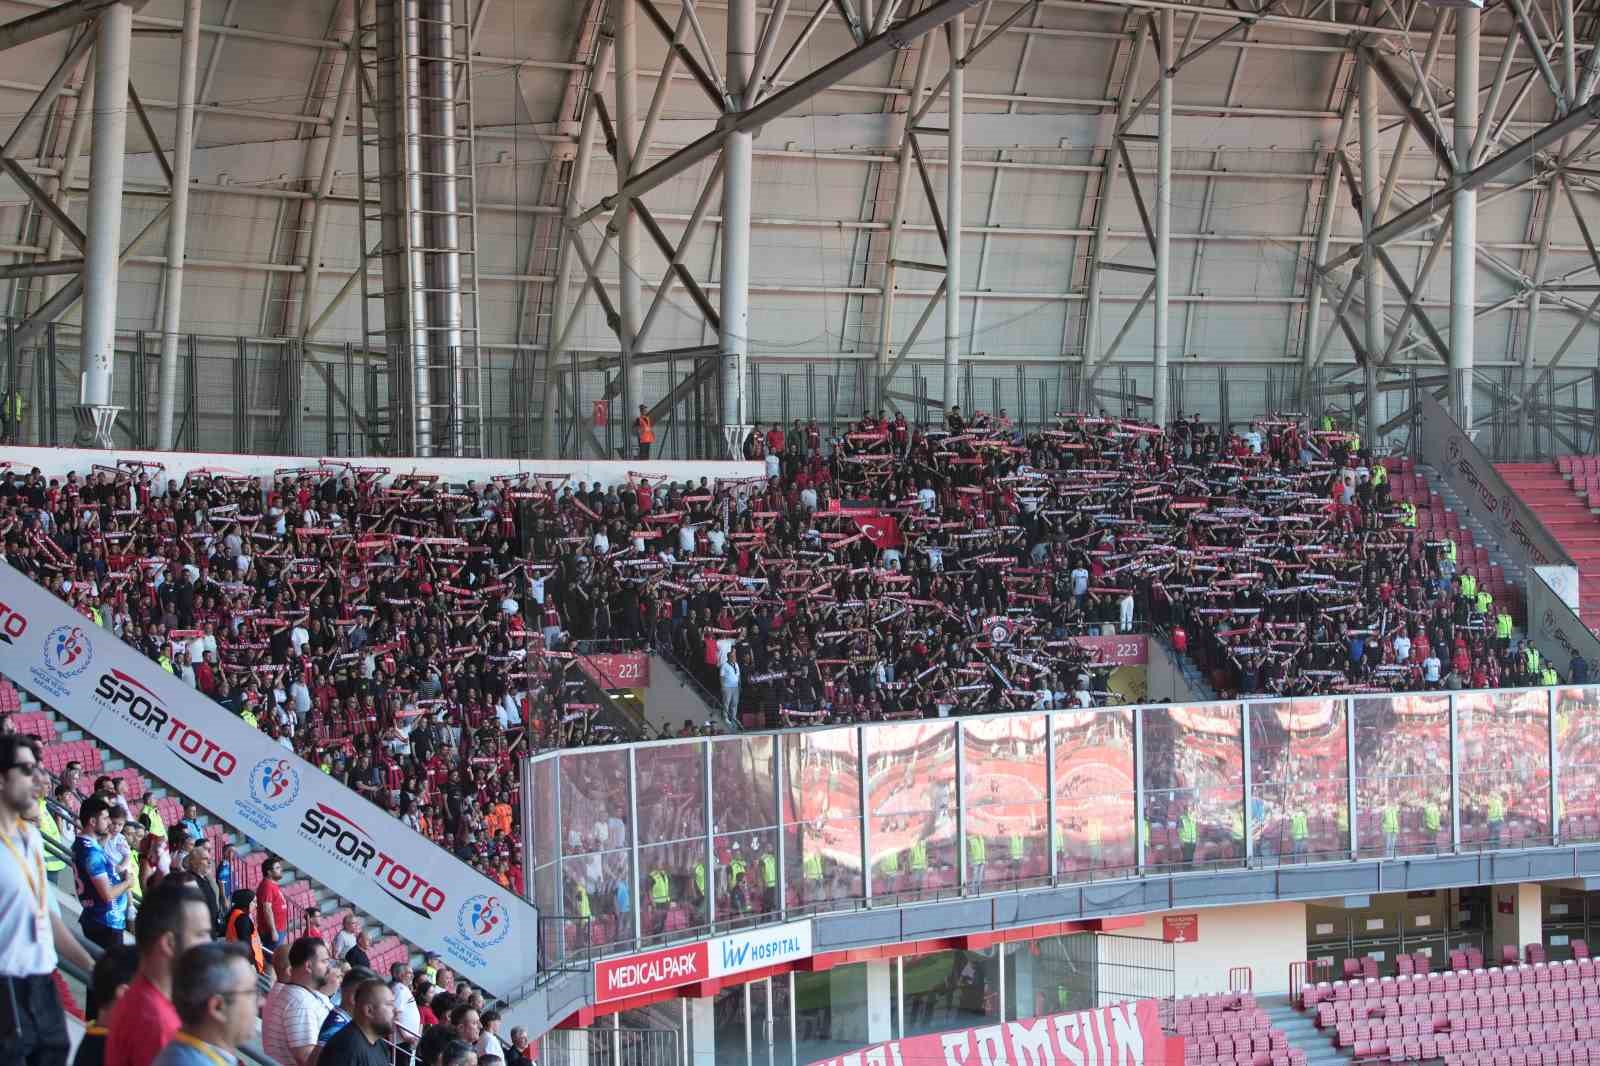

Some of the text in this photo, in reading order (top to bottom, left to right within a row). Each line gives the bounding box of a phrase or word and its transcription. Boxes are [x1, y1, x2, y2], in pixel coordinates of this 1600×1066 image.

[1117, 643, 1138, 657] 223
[619, 663, 639, 679] 221
[751, 936, 800, 960] HOSPITAL
